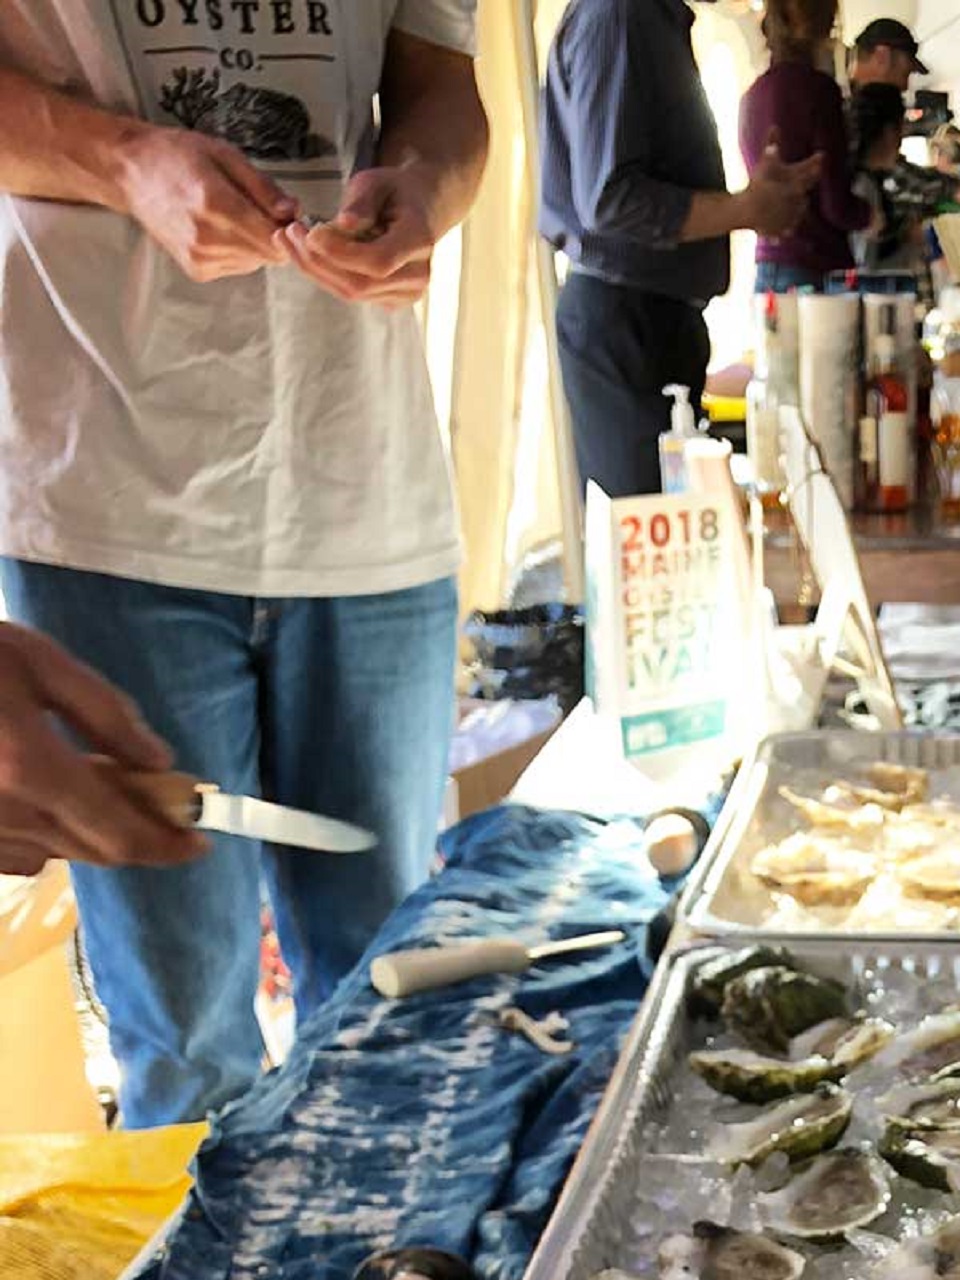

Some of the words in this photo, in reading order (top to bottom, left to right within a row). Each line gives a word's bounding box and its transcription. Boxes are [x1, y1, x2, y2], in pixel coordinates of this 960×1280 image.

[137, 0, 332, 35] OYSTER
[219, 47, 263, 71] CO.
[620, 508, 720, 551] 2018
